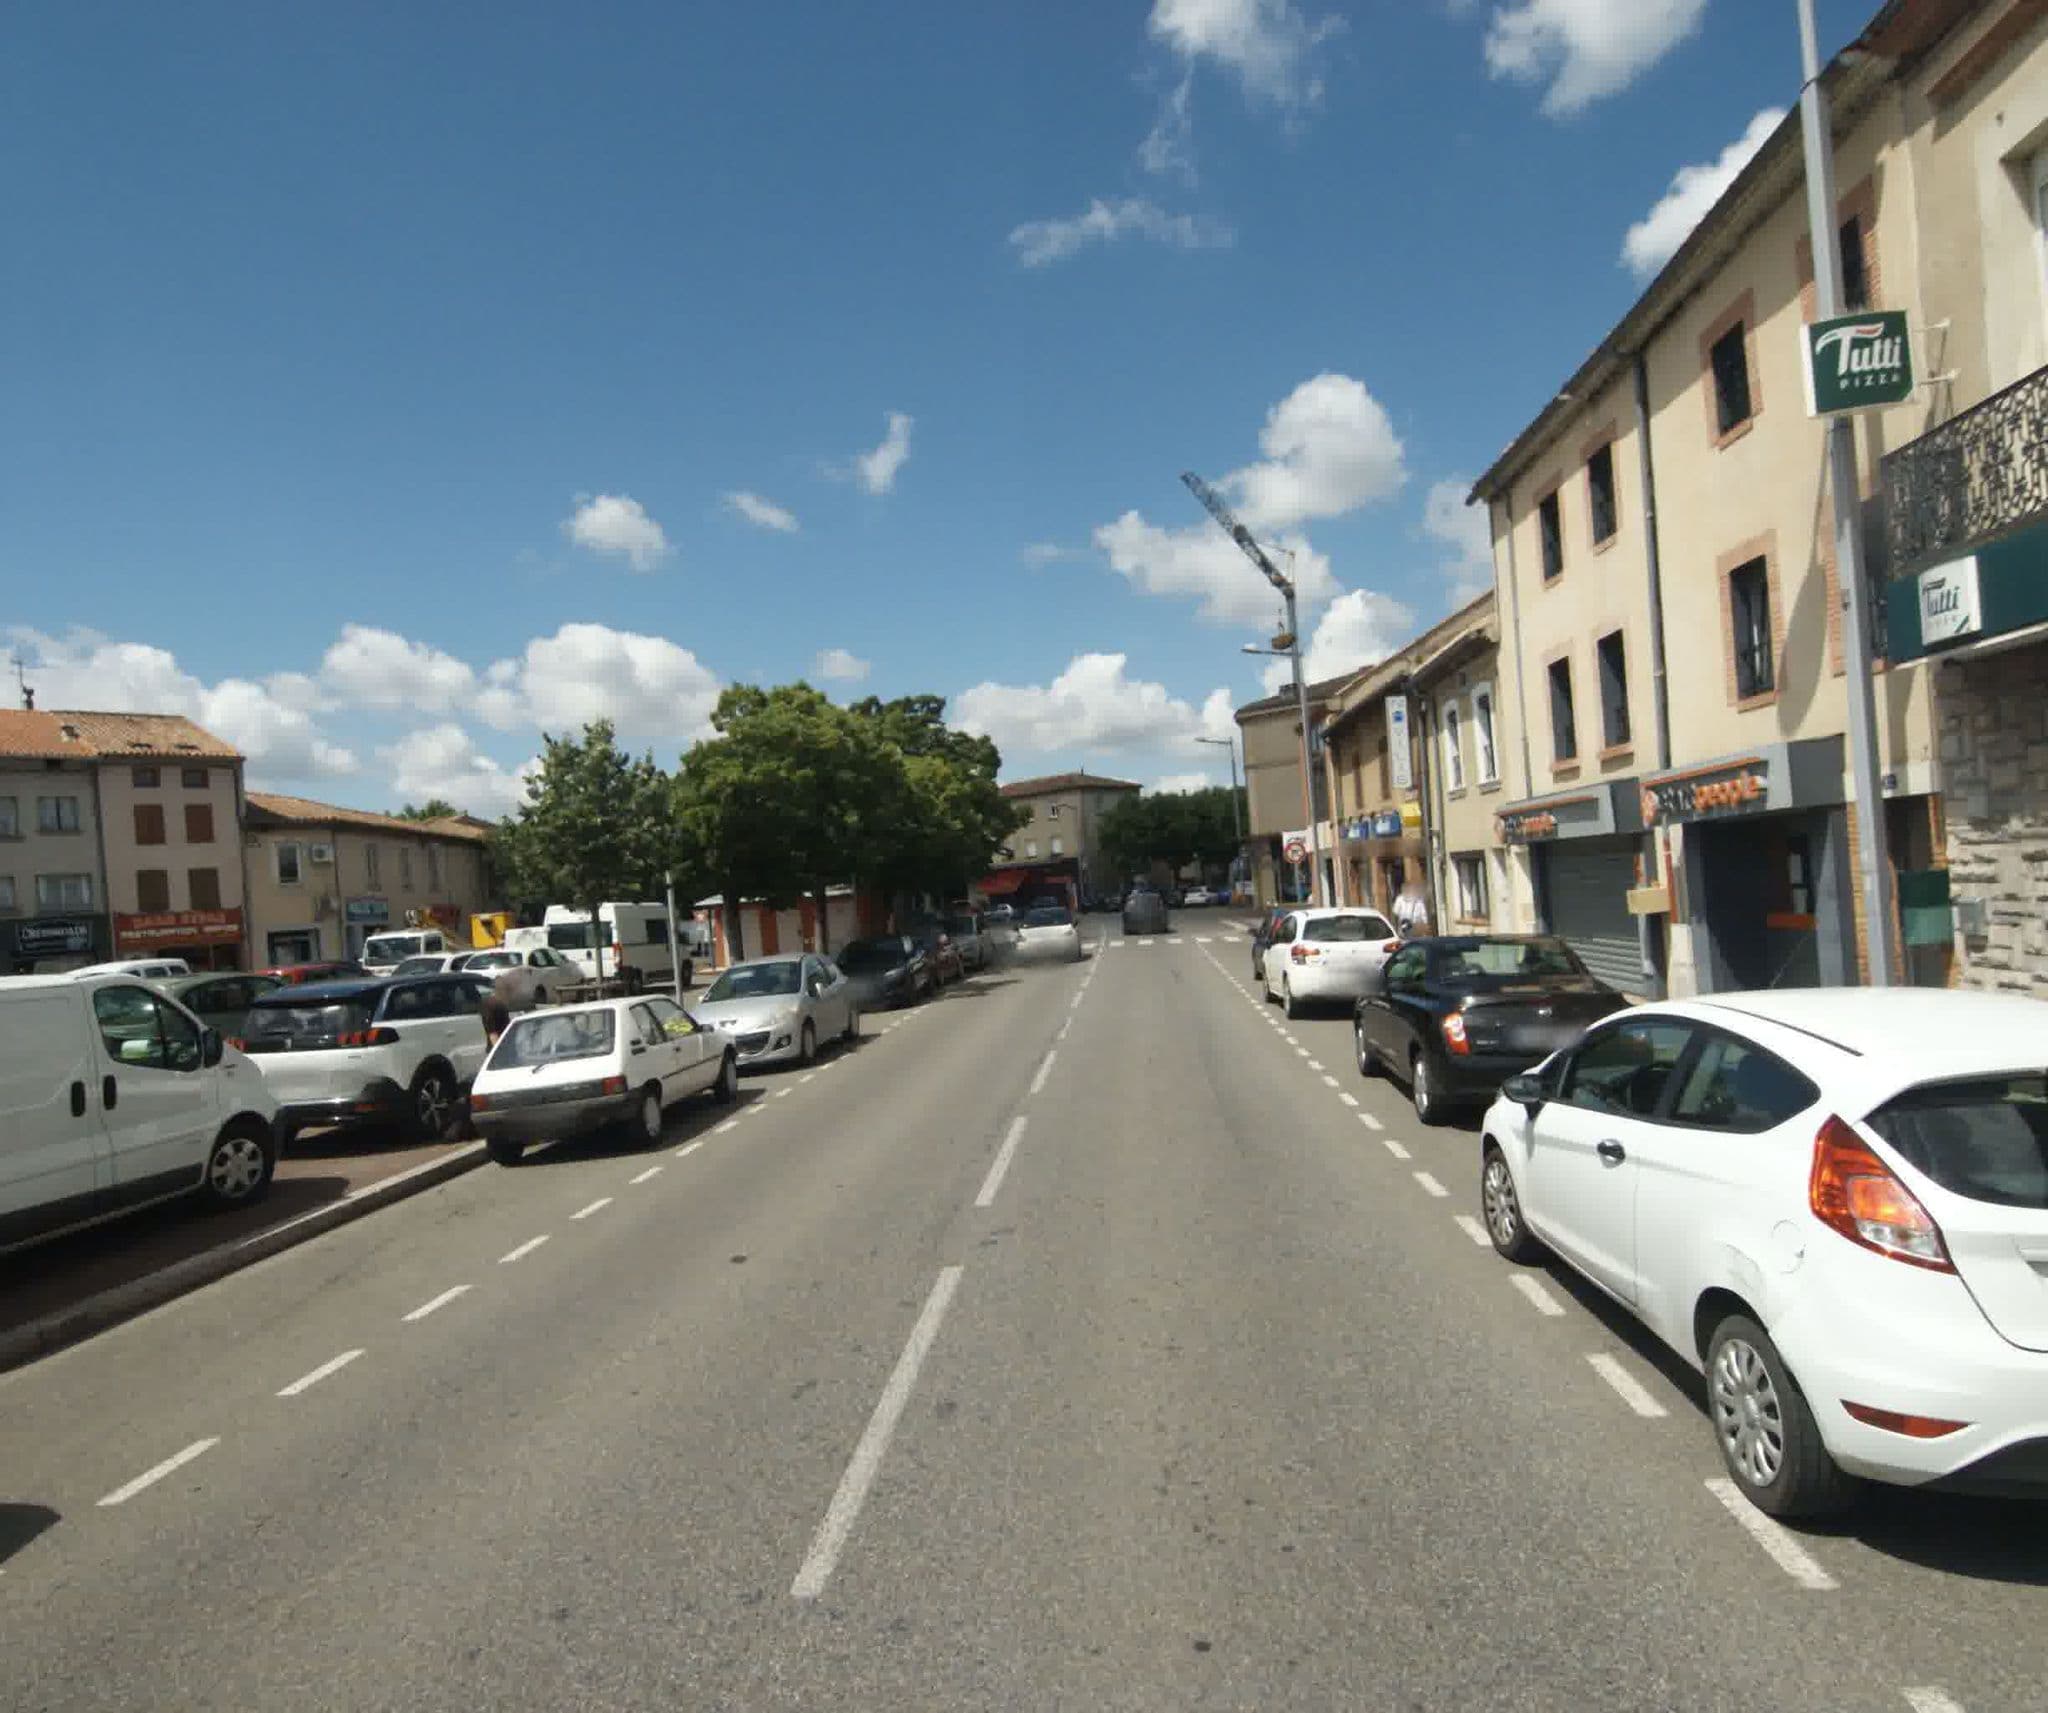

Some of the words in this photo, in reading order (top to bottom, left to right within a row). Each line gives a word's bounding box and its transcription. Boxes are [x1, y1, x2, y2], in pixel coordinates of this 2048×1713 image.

[1815, 321, 1902, 376] Tutti
[1839, 373, 1900, 391] PIZZA
[1922, 577, 1960, 618] Tutti
